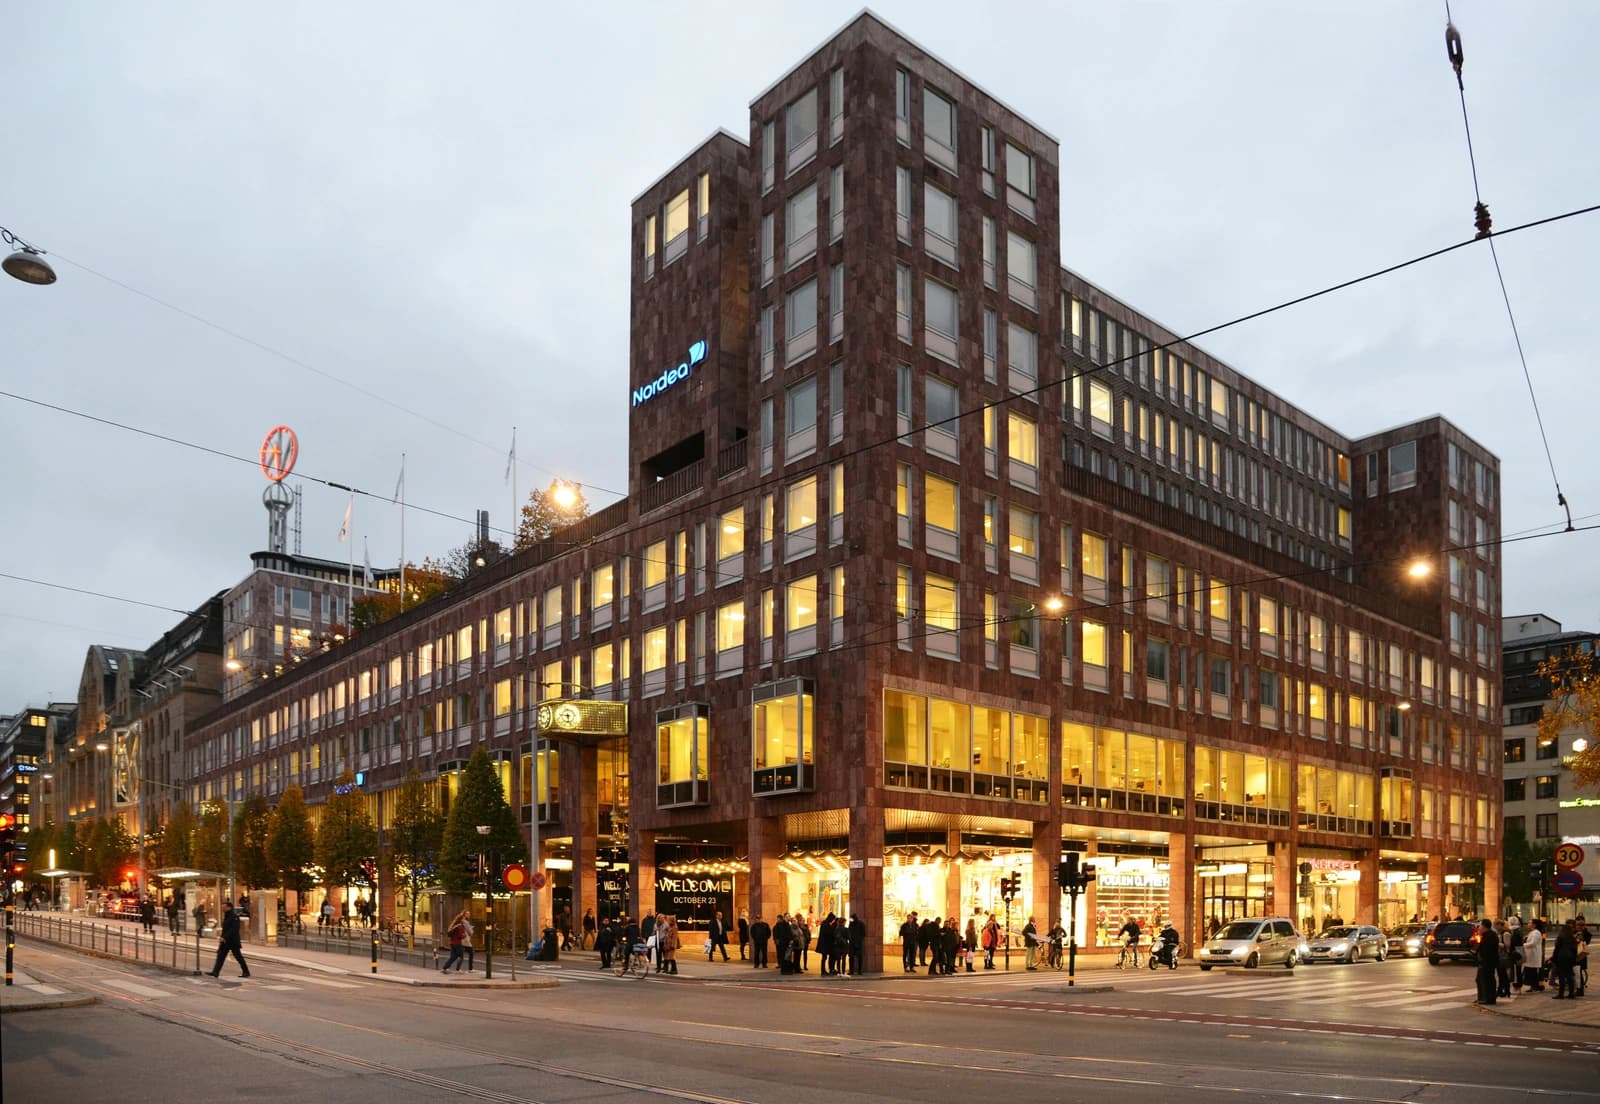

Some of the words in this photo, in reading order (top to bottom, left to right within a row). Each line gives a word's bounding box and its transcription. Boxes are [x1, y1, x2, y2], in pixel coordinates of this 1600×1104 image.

[632, 362, 689, 407] Nordea
[1559, 850, 1580, 862] 30
[659, 879, 731, 893] WELCOME
[673, 896, 707, 904] OCTOBER
